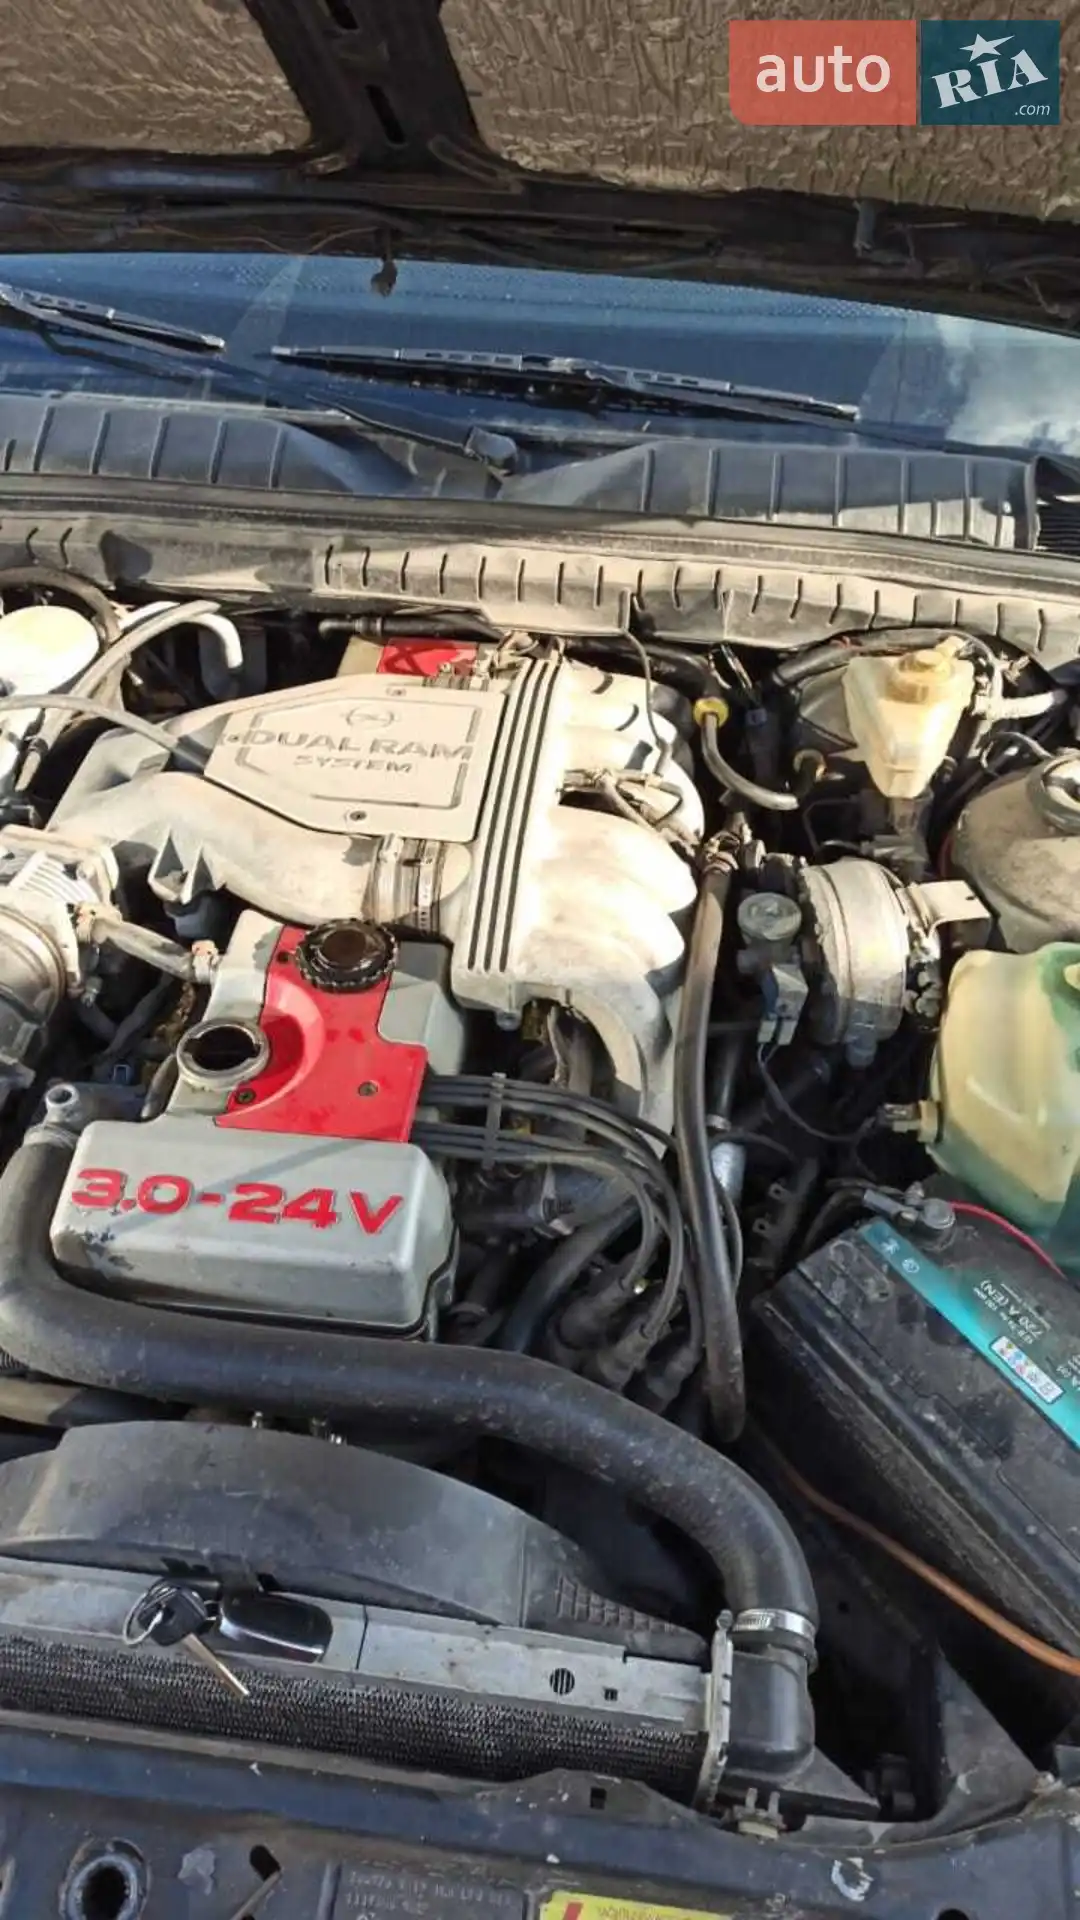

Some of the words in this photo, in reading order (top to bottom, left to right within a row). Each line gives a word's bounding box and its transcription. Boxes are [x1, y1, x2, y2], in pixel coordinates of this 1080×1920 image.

[248, 730, 361, 752] DUAL
[369, 738, 473, 760] RAM
[292, 754, 413, 774] SYSTEM
